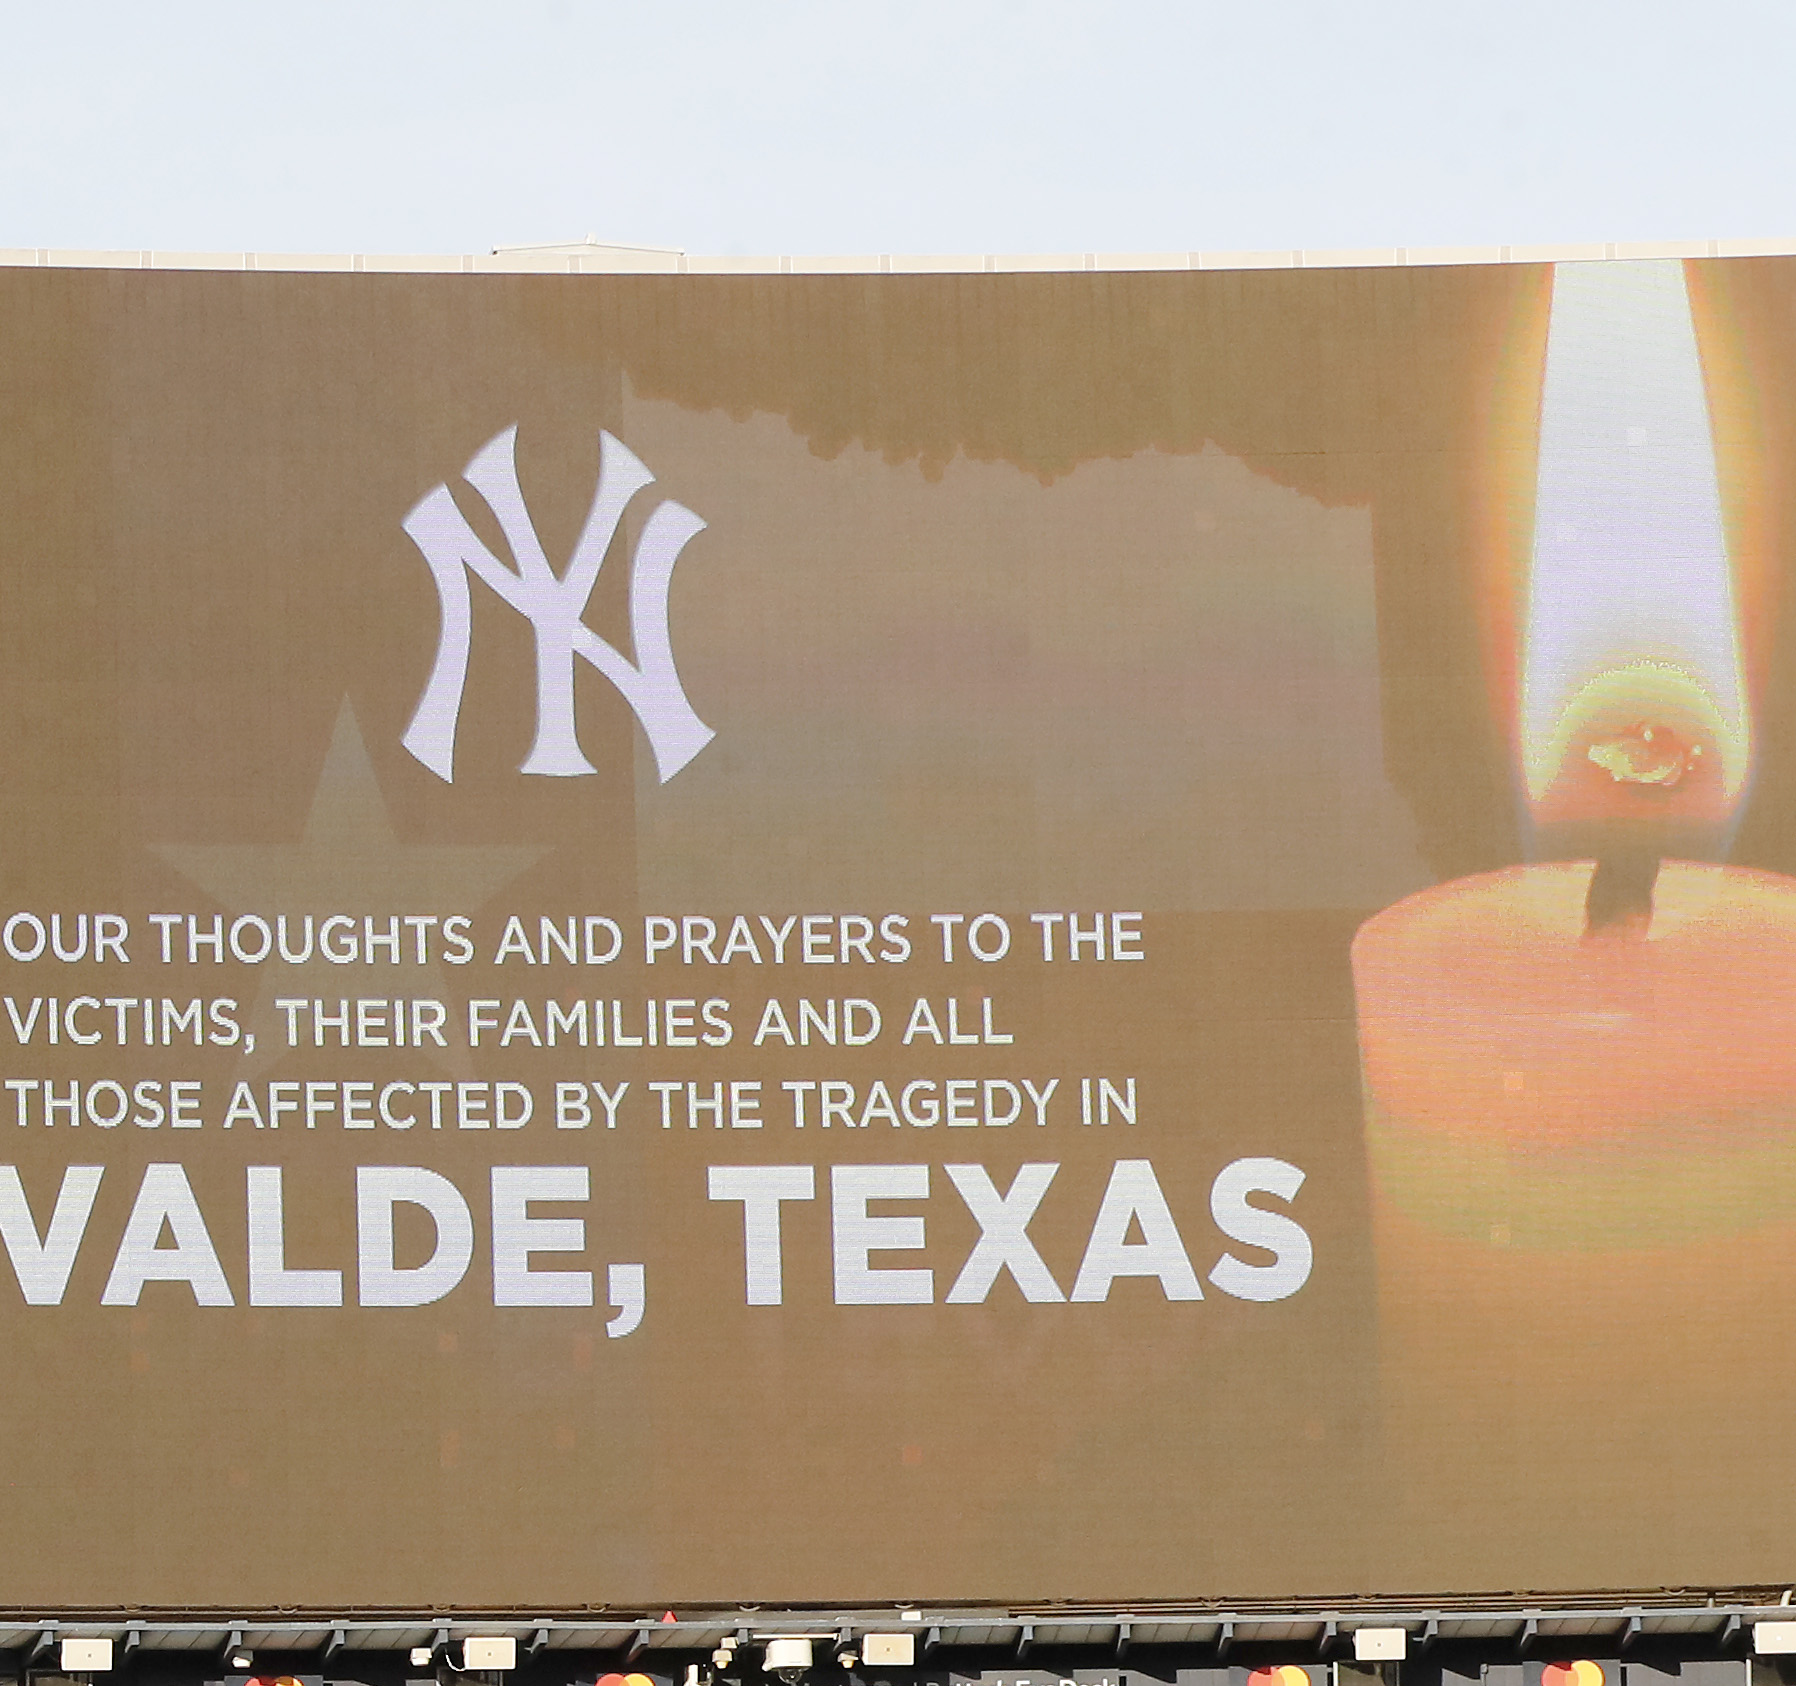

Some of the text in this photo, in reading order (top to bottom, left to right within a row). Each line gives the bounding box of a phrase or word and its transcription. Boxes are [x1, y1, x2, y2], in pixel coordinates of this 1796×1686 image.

[3, 911, 1145, 965] OUR THOUGHTS AND PRAYERS TO THE
[4, 997, 1015, 1054] VICTIMS, THEIR FAMILIES AND ALL
[4, 1078, 1138, 1130] THOSE AFFECTED BY THE TRAGEDY IN
[706, 1157, 1316, 1308] TEXAS
